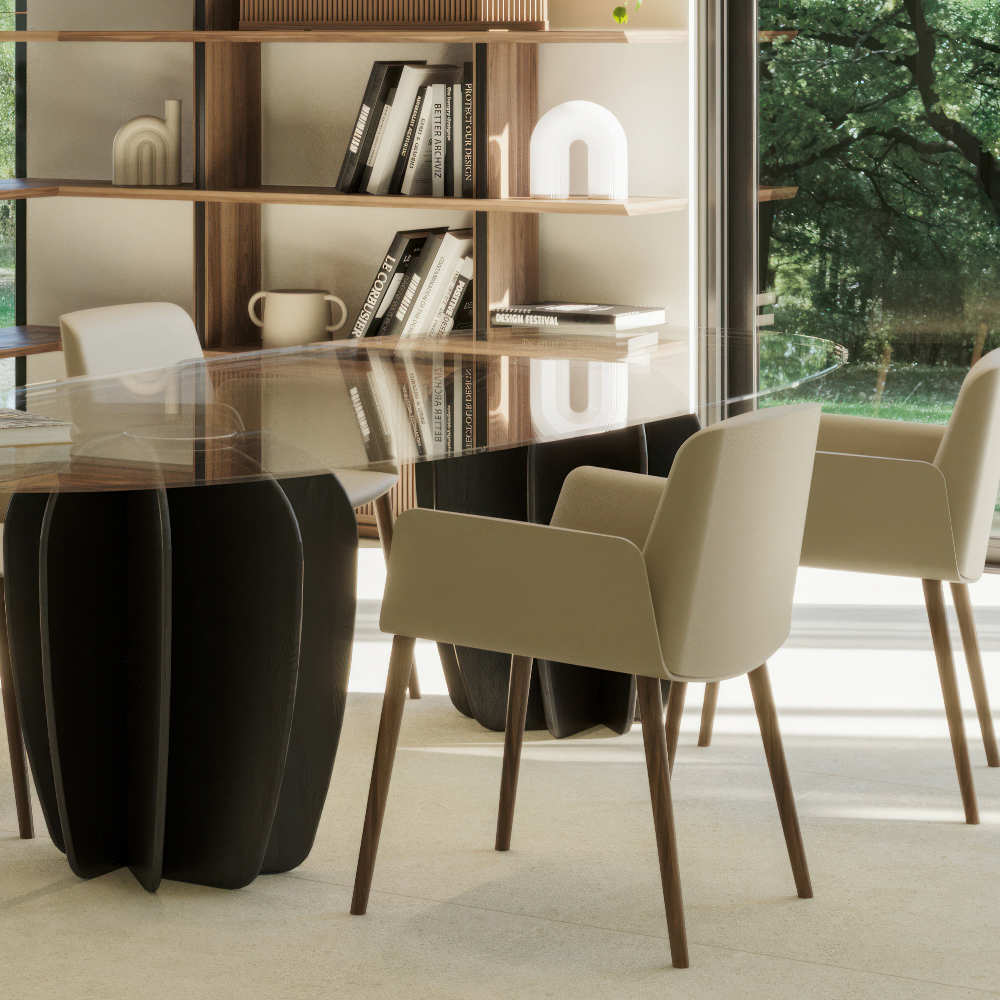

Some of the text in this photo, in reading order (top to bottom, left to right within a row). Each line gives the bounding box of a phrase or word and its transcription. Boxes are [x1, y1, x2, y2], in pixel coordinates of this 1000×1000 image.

[433, 103, 442, 178] BETTER ARCHVIZ
[462, 83, 473, 181] PROTECT OUR DESIGN
[351, 254, 397, 338] LE CORBUSIER
[444, 280, 466, 318] POSITIVE
[495, 313, 559, 327] DESIGN FESTIVAL
